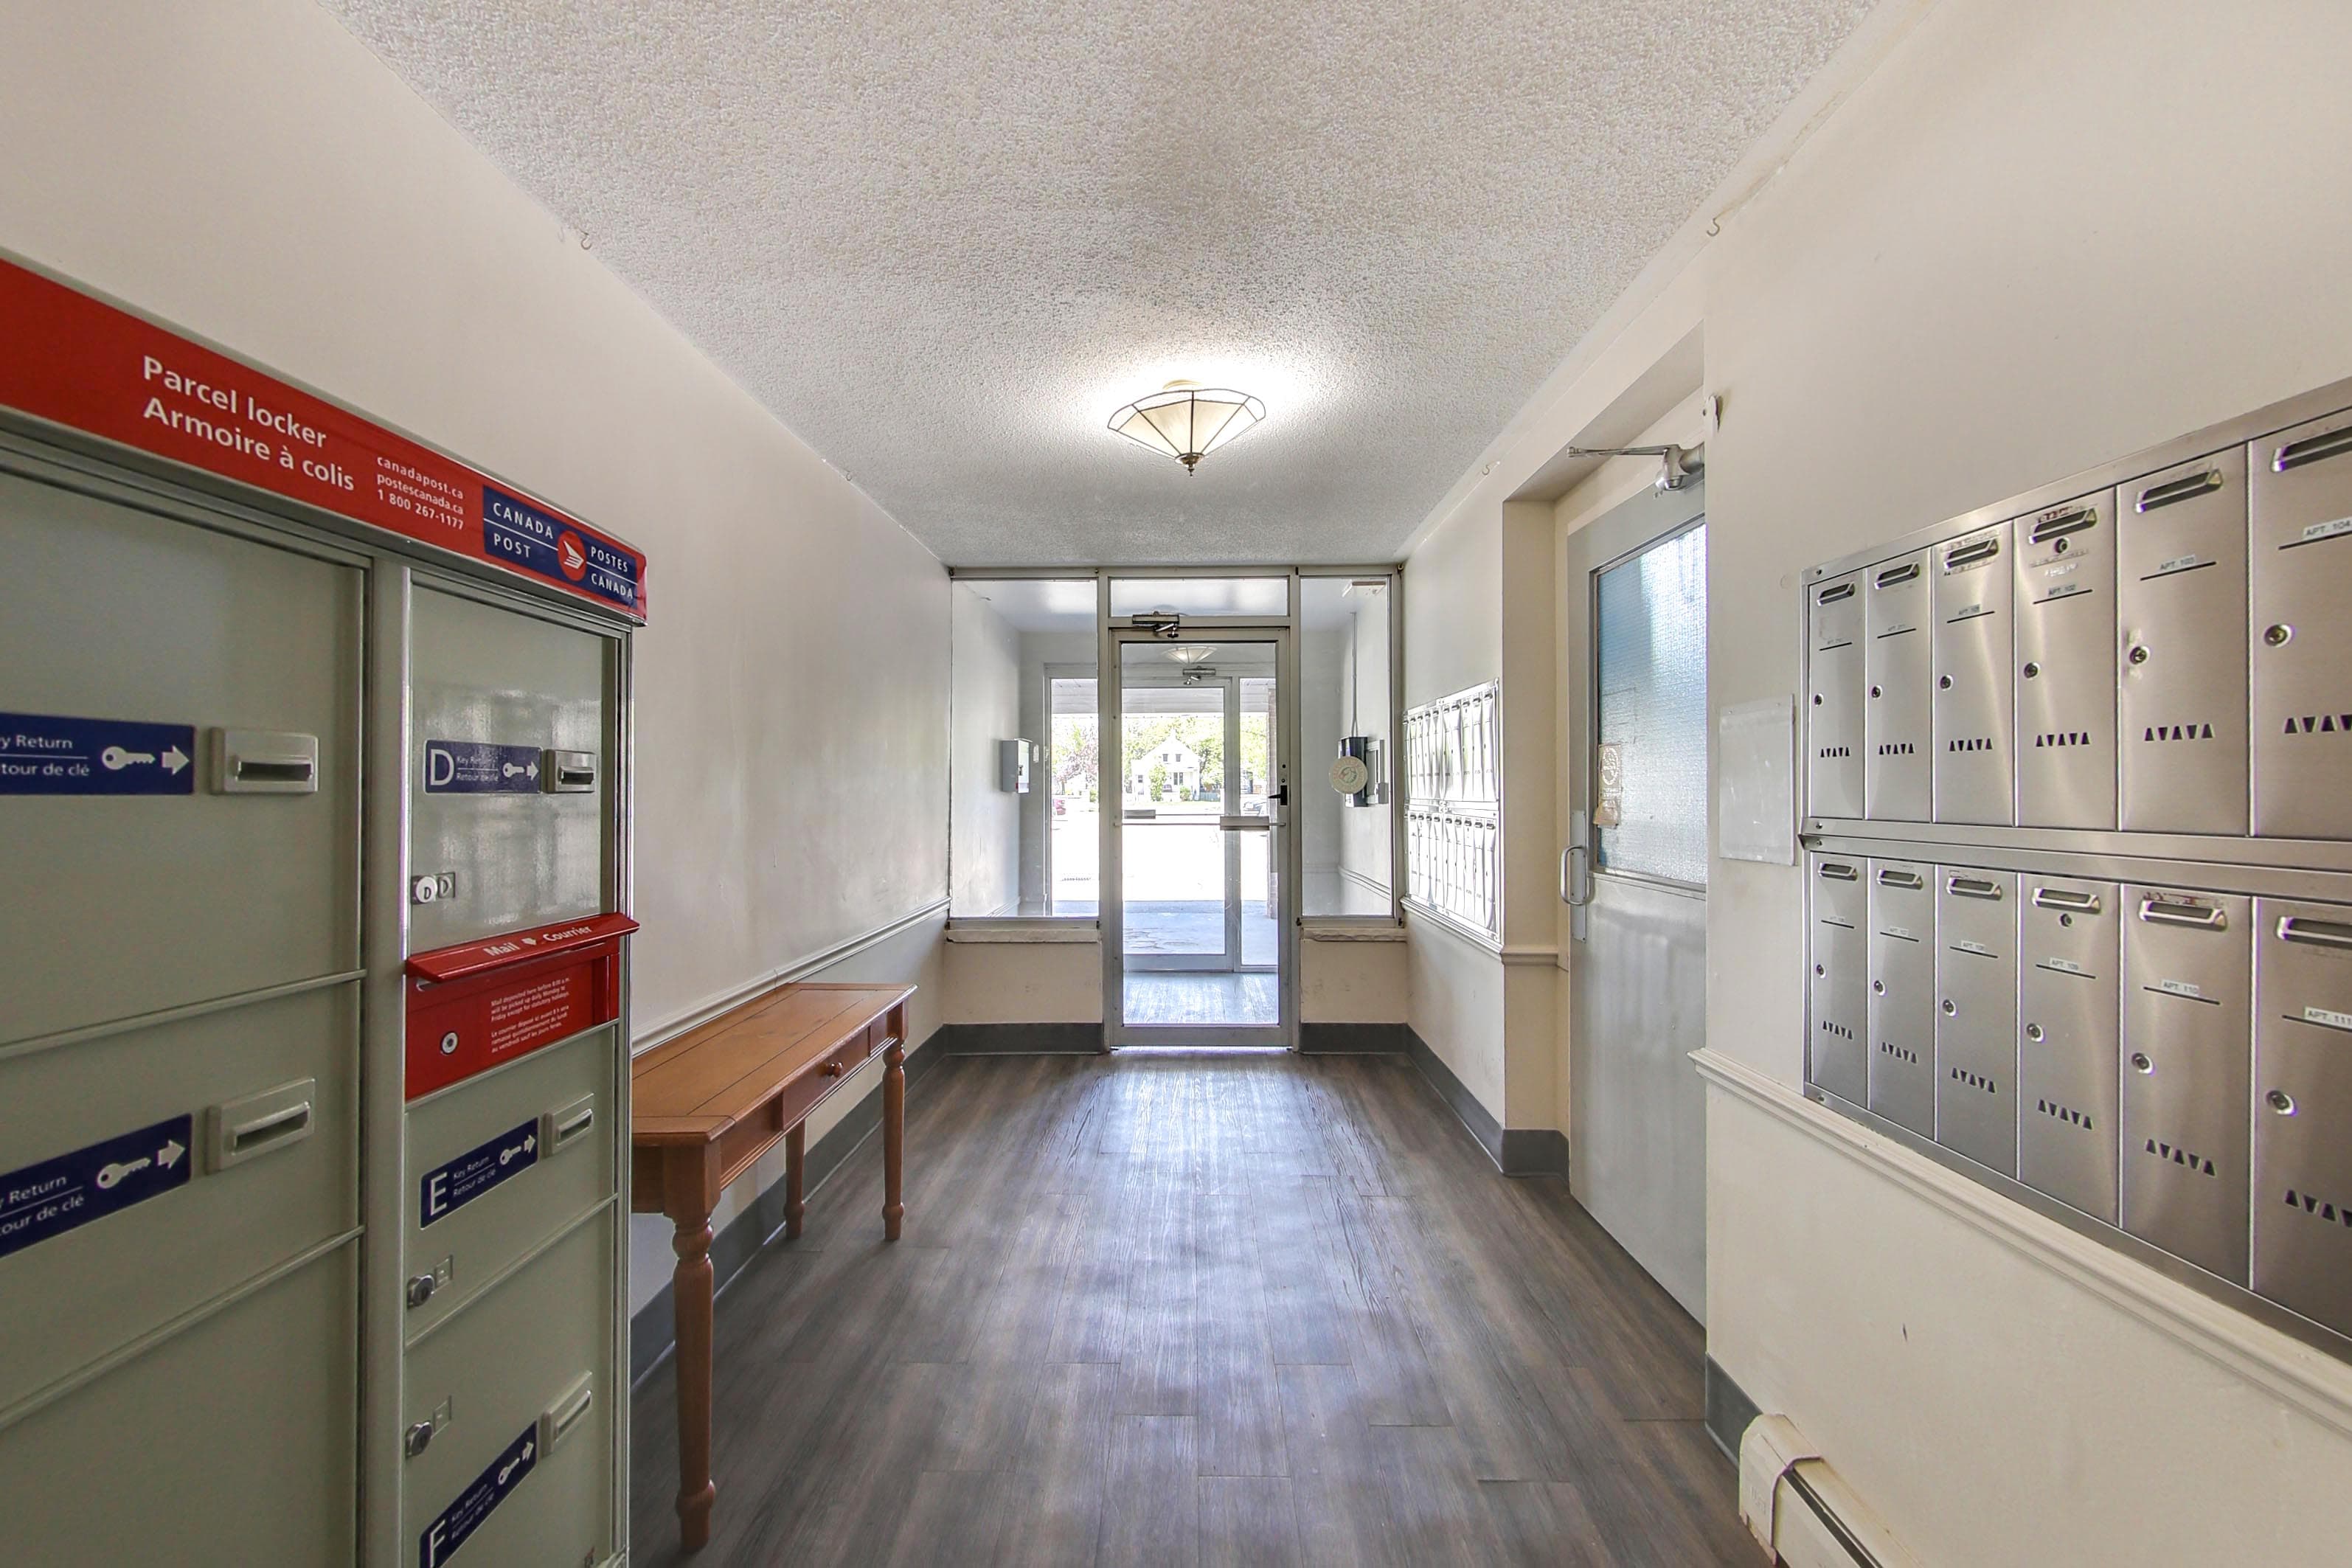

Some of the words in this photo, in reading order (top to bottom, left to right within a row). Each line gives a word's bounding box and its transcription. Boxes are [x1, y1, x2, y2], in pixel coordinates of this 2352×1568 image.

[144, 355, 237, 413] Parcel
[248, 397, 326, 448] locker
[144, 398, 271, 460] Armoire
[279, 445, 294, 469] à
[302, 460, 354, 490] colis
[377, 457, 463, 499] canadapost.ca
[377, 474, 463, 515] postescanada.ca
[378, 489, 384, 500] 1
[389, 493, 411, 510] 800
[415, 503, 463, 530] 267-1177
[493, 502, 553, 539] CANADA
[494, 533, 530, 558] POST
[591, 546, 628, 572] POSTES
[591, 574, 634, 600] CANADA
[16, 735, 72, 749] Return
[43, 763, 63, 775] de
[69, 763, 90, 776] clé
[430, 749, 454, 785] D
[423, 887, 431, 899] D
[483, 942, 520, 956] Mail
[543, 926, 592, 941] Courrier
[9, 1176, 67, 1204] Return
[430, 1172, 448, 1216] E
[0, 1217, 31, 1236] our
[36, 1207, 58, 1221] de
[61, 1194, 85, 1211] clé
[429, 1519, 445, 1568] F
